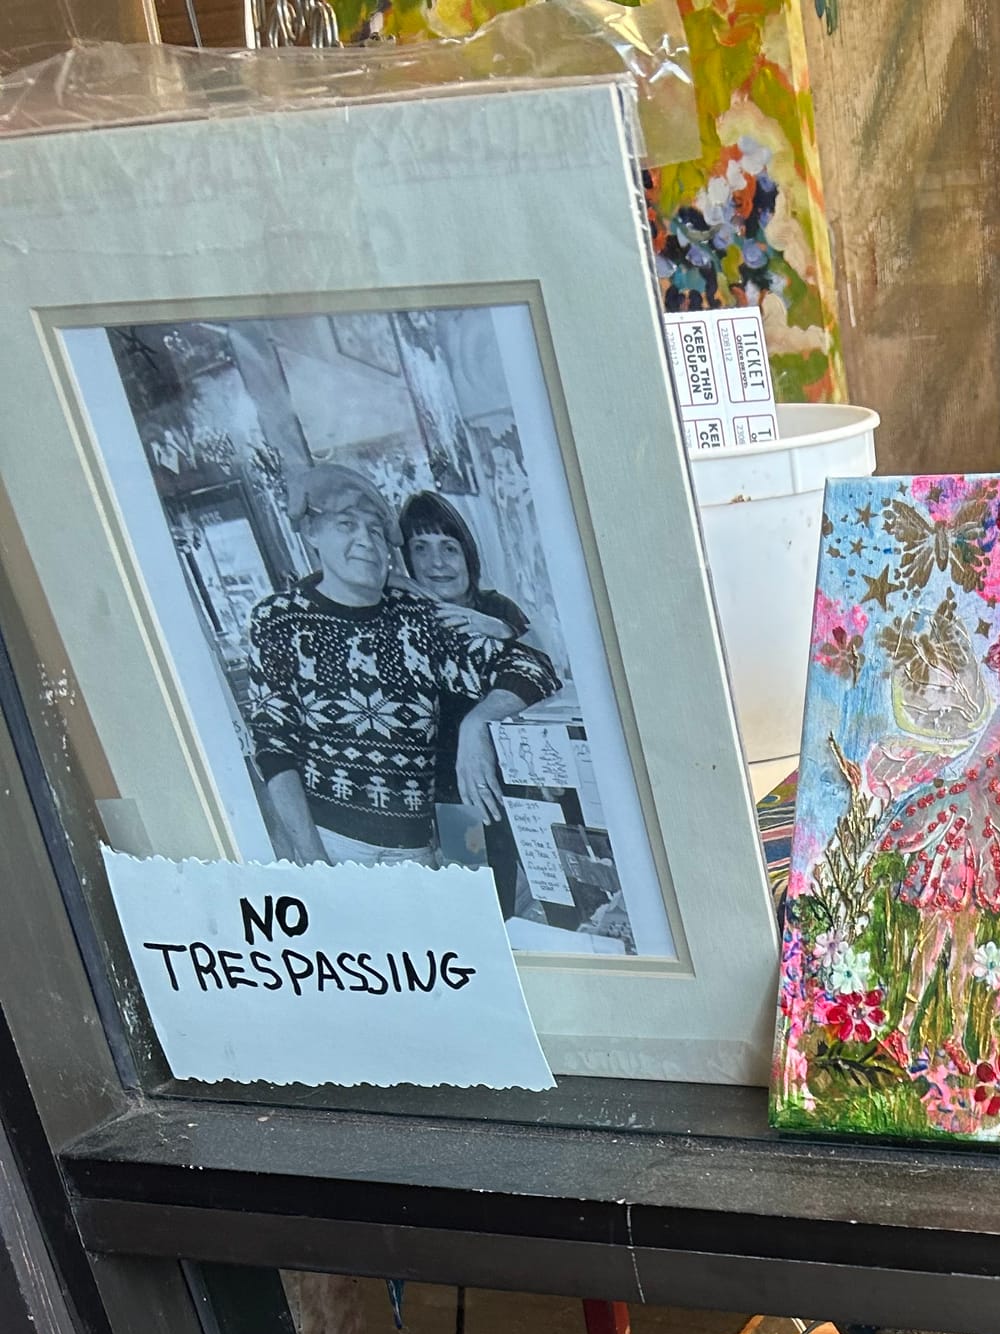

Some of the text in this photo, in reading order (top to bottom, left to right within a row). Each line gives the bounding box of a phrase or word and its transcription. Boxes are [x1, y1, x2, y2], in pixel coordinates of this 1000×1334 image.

[683, 333, 702, 394] COUPON
[692, 326, 713, 400] KEEP THIS
[720, 327, 733, 362] 2308112
[736, 335, 745, 361] Office
[742, 330, 765, 389] TICKET
[240, 895, 309, 946] NO
[143, 941, 477, 996] TRESPASSING
